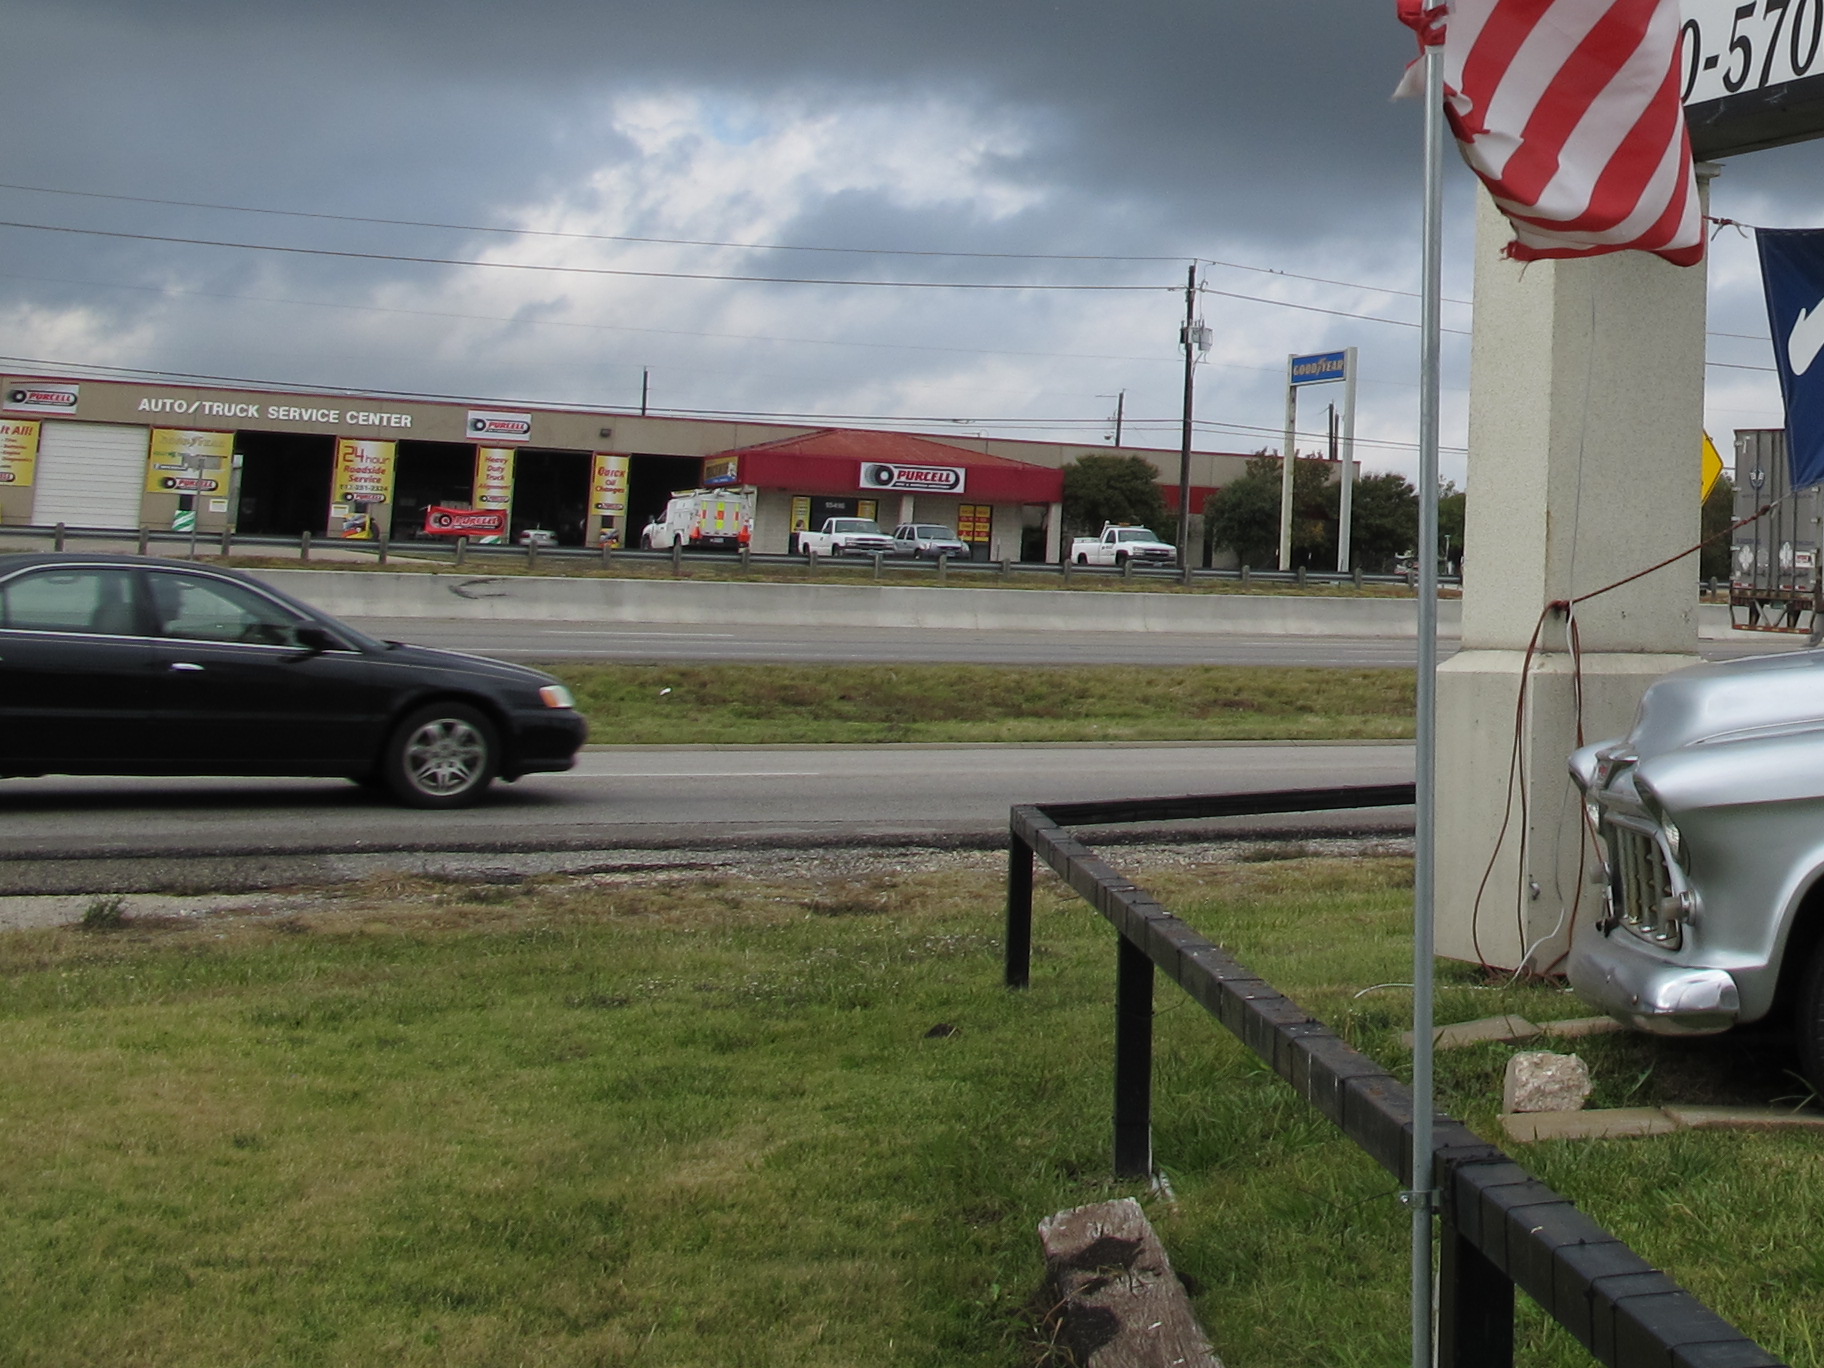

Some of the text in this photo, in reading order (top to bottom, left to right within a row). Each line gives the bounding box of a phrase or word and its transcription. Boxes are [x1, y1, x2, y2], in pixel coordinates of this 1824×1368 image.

[1293, 358, 1344, 375] GOODYEAR
[29, 392, 71, 402] PURCELL
[138, 398, 412, 427] AUTO/TRUCK SERVICE CENTER
[488, 420, 525, 430] PURCELL
[343, 445, 391, 464] 24 hour
[344, 465, 386, 475] Roadside
[349, 475, 382, 483] Service
[896, 470, 952, 483] PURCELL
